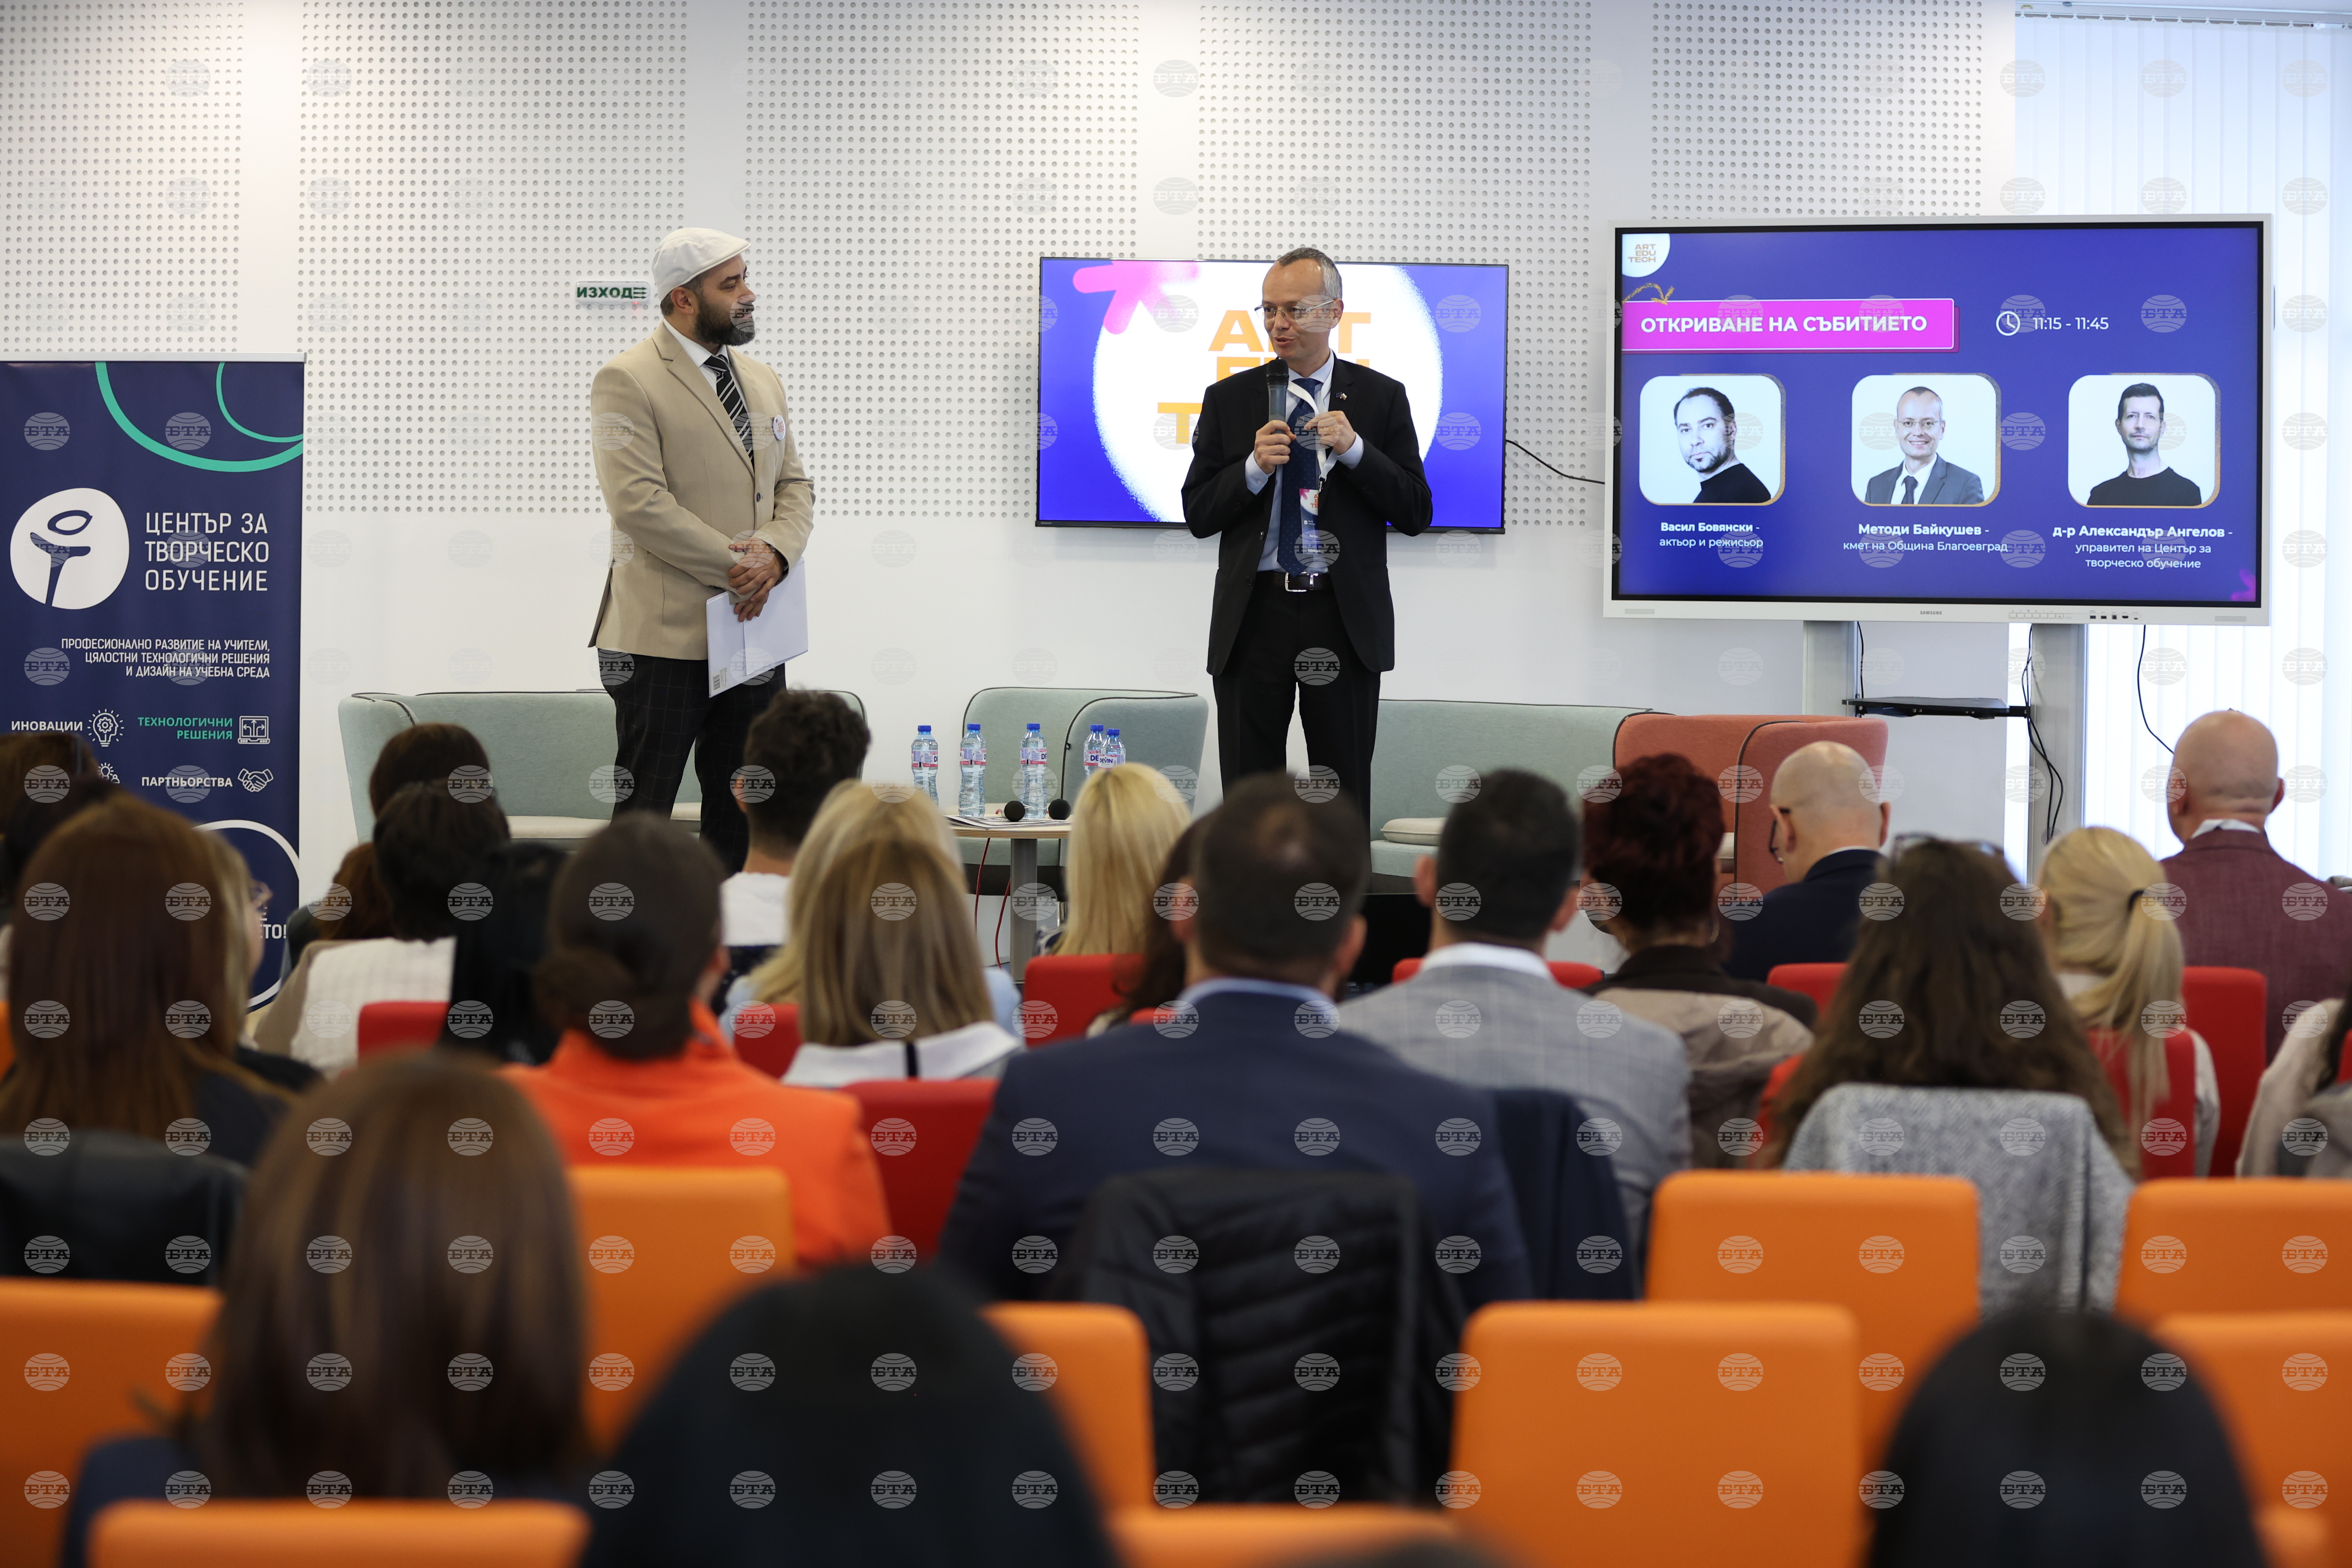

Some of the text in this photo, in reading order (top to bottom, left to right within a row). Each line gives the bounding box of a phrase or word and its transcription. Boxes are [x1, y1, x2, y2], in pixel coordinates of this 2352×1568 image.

[577, 287, 632, 299] ИЗХОД
[1640, 315, 1927, 333] ОТКРИВАНЕ НА СЪБИТИЕТО
[2032, 317, 2062, 330] 11:15
[2075, 317, 2109, 330] 11:45
[1208, 310, 1371, 354] AT
[146, 512, 267, 534] ЦЕНТЪР ЗА
[1661, 522, 1695, 532] Васил
[1698, 522, 1753, 532] Бовянски
[1858, 524, 1910, 536] Методи
[1913, 523, 1982, 537] Байкушев
[2053, 527, 2076, 538] д-р
[2078, 525, 2164, 538] Александър
[2167, 526, 2225, 537] Ангелов
[1659, 538, 1697, 549] актьор
[1709, 539, 1764, 549] режисьор
[1843, 542, 1869, 550] кмет
[1887, 540, 1934, 552] Община
[1937, 541, 2008, 553] Благоевград
[2075, 544, 2135, 554] управител
[2154, 544, 2197, 555] Център
[145, 541, 269, 562] ТВОРЧЕСКО
[2085, 557, 2201, 570] творческо обучение
[145, 570, 268, 591] ОБУЧЕНИЕ
[62, 638, 270, 652] ПРОФЕСИОНАЛНО РАЗВИТИЕ НА УЧИТЕЛИ,
[85, 652, 270, 664] ЦЯЛОСТНИ ТЕХНОЛОГИЧНИ РЕШЕНИЯ
[126, 664, 270, 679] И ДИЗАЙН НА УЧЕБНА СРЕДА
[11, 721, 83, 732] ИНОВАЦИИ
[138, 717, 232, 727] ТЕХНОЛОГИЧНИ
[177, 730, 232, 740] РЕШЕНИЯ
[142, 777, 232, 787] ПАРТНЬОРСТВА
